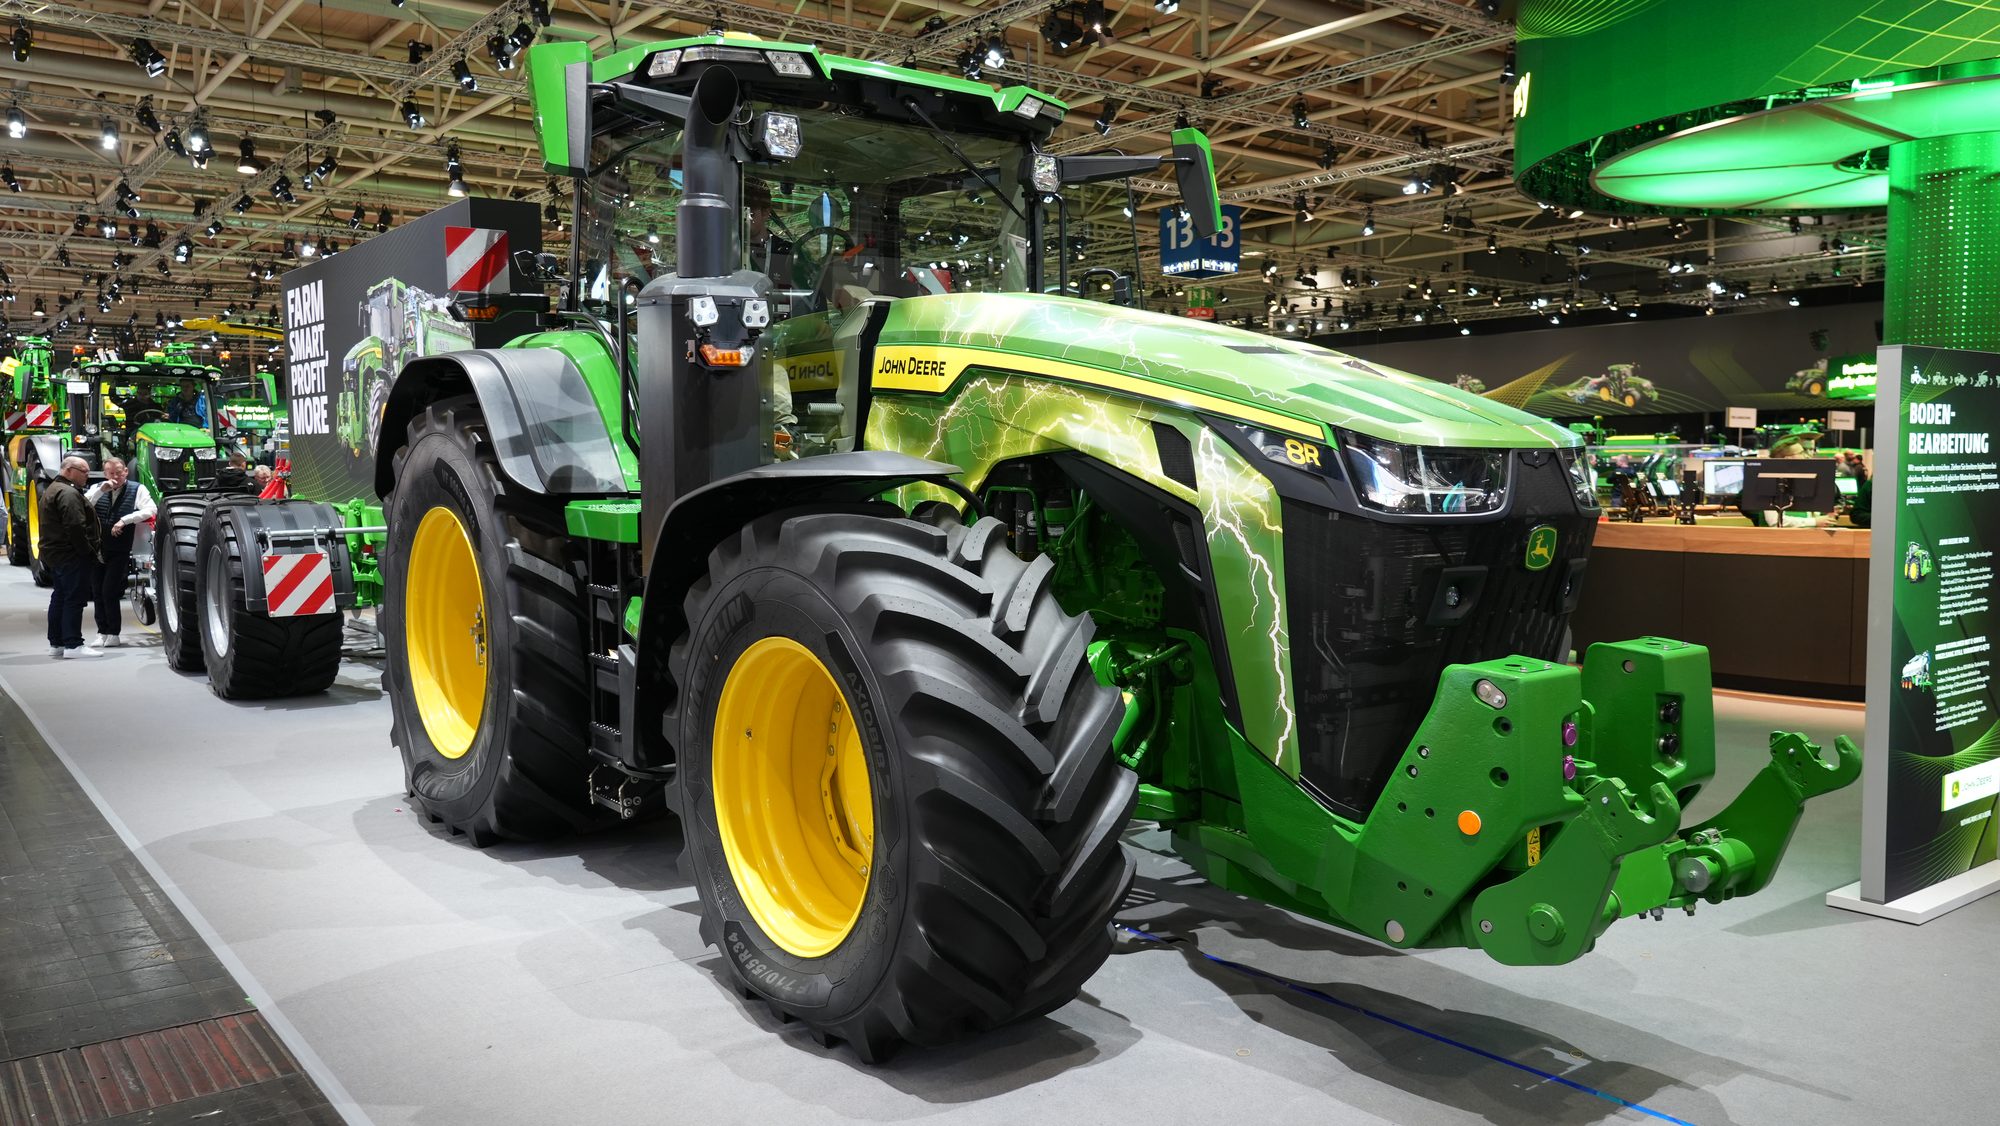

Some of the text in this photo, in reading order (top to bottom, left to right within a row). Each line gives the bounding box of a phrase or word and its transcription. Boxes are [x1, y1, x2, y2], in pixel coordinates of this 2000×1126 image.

[1167, 216, 1193, 249] 13
[287, 280, 324, 329] FARM
[289, 323, 328, 366] SMART,
[291, 359, 326, 396] PROFIT
[879, 356, 946, 376] JOHN DEERE
[292, 395, 329, 435] MORE
[1909, 402, 1956, 424] BODEN-
[1285, 438, 1321, 467] 8R
[1909, 432, 1989, 454] BEARBEITUNG
[847, 671, 886, 769] AXIOBIB
[727, 931, 797, 991] 710/55R34
